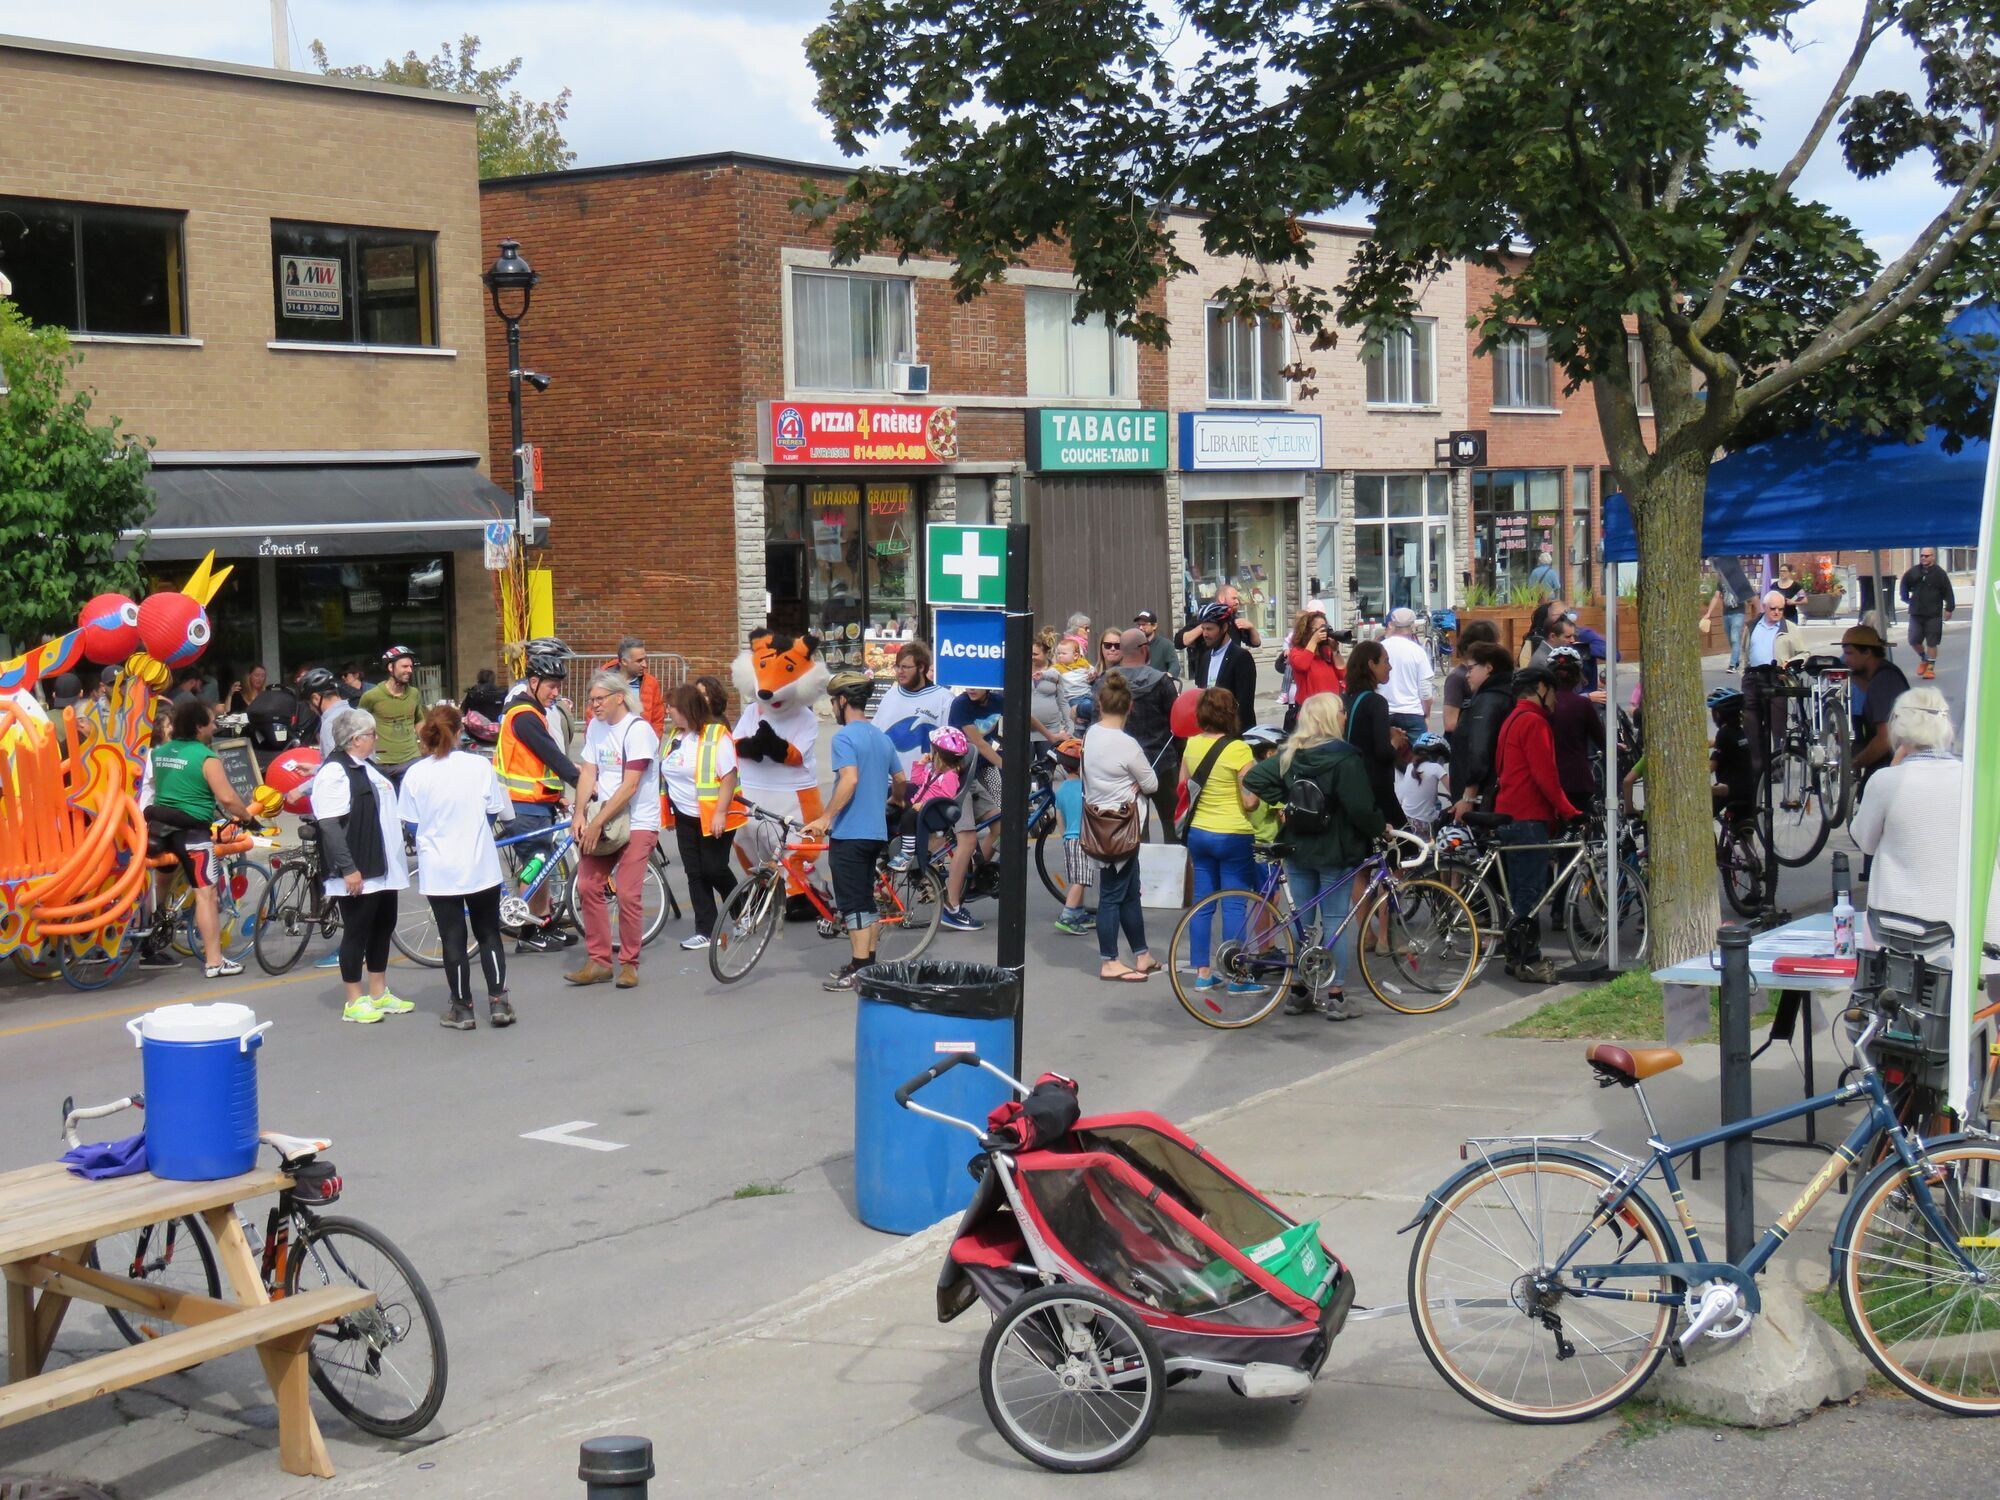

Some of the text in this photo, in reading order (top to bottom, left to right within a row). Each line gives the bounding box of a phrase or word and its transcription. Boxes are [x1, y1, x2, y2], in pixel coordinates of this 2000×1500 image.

[782, 419, 799, 439] 4
[811, 408, 922, 440] PIZZA 4 FRÈRES
[1052, 415, 1156, 442] TABAGIE
[1201, 428, 1259, 452] LIBRAIRIE
[1458, 441, 1474, 456] M
[810, 447, 850, 459] LIVRAISON
[1061, 448, 1138, 463] COUCHE-TARD
[813, 490, 860, 506] LIVRAISON
[259, 544, 270, 556] Le
[270, 544, 293, 556] Petit
[940, 638, 1006, 659] Accuei
[1787, 1161, 1834, 1224] HUFFY
